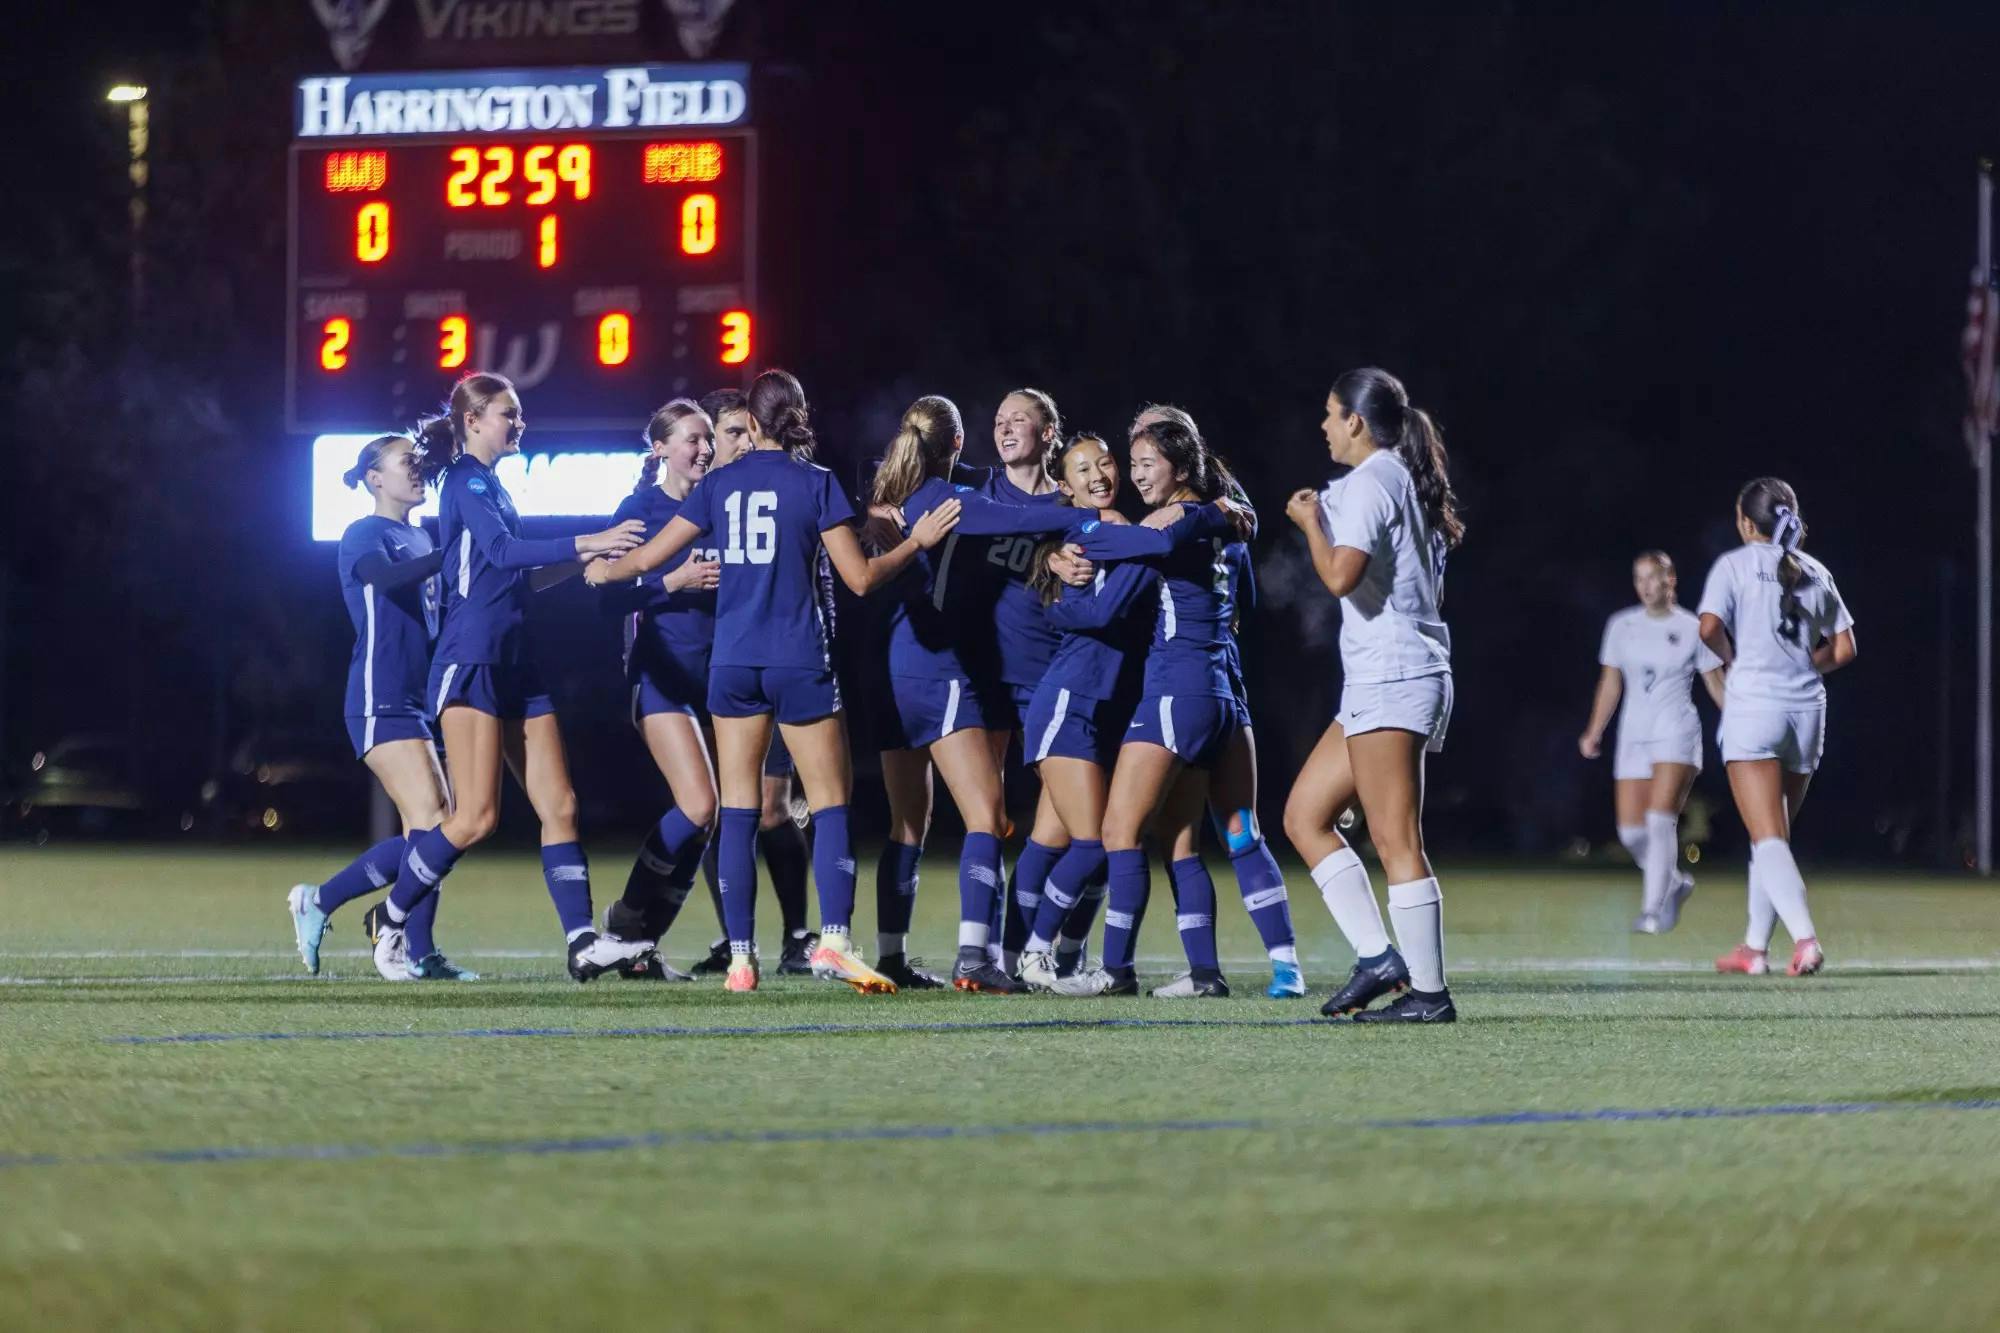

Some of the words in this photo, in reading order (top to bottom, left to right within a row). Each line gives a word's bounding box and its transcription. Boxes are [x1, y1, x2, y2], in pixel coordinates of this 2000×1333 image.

[415, 0, 642, 39] VIKINGS
[299, 76, 597, 136] HARRINGTON
[604, 68, 746, 127] FIELD
[357, 202, 389, 262] 0
[539, 213, 557, 267] 1
[682, 194, 716, 255] 0
[321, 318, 350, 370] 2
[440, 316, 467, 368] 3
[599, 313, 629, 365] 0
[721, 311, 750, 363] 3
[723, 490, 778, 565] 16
[987, 536, 1034, 572] 20
